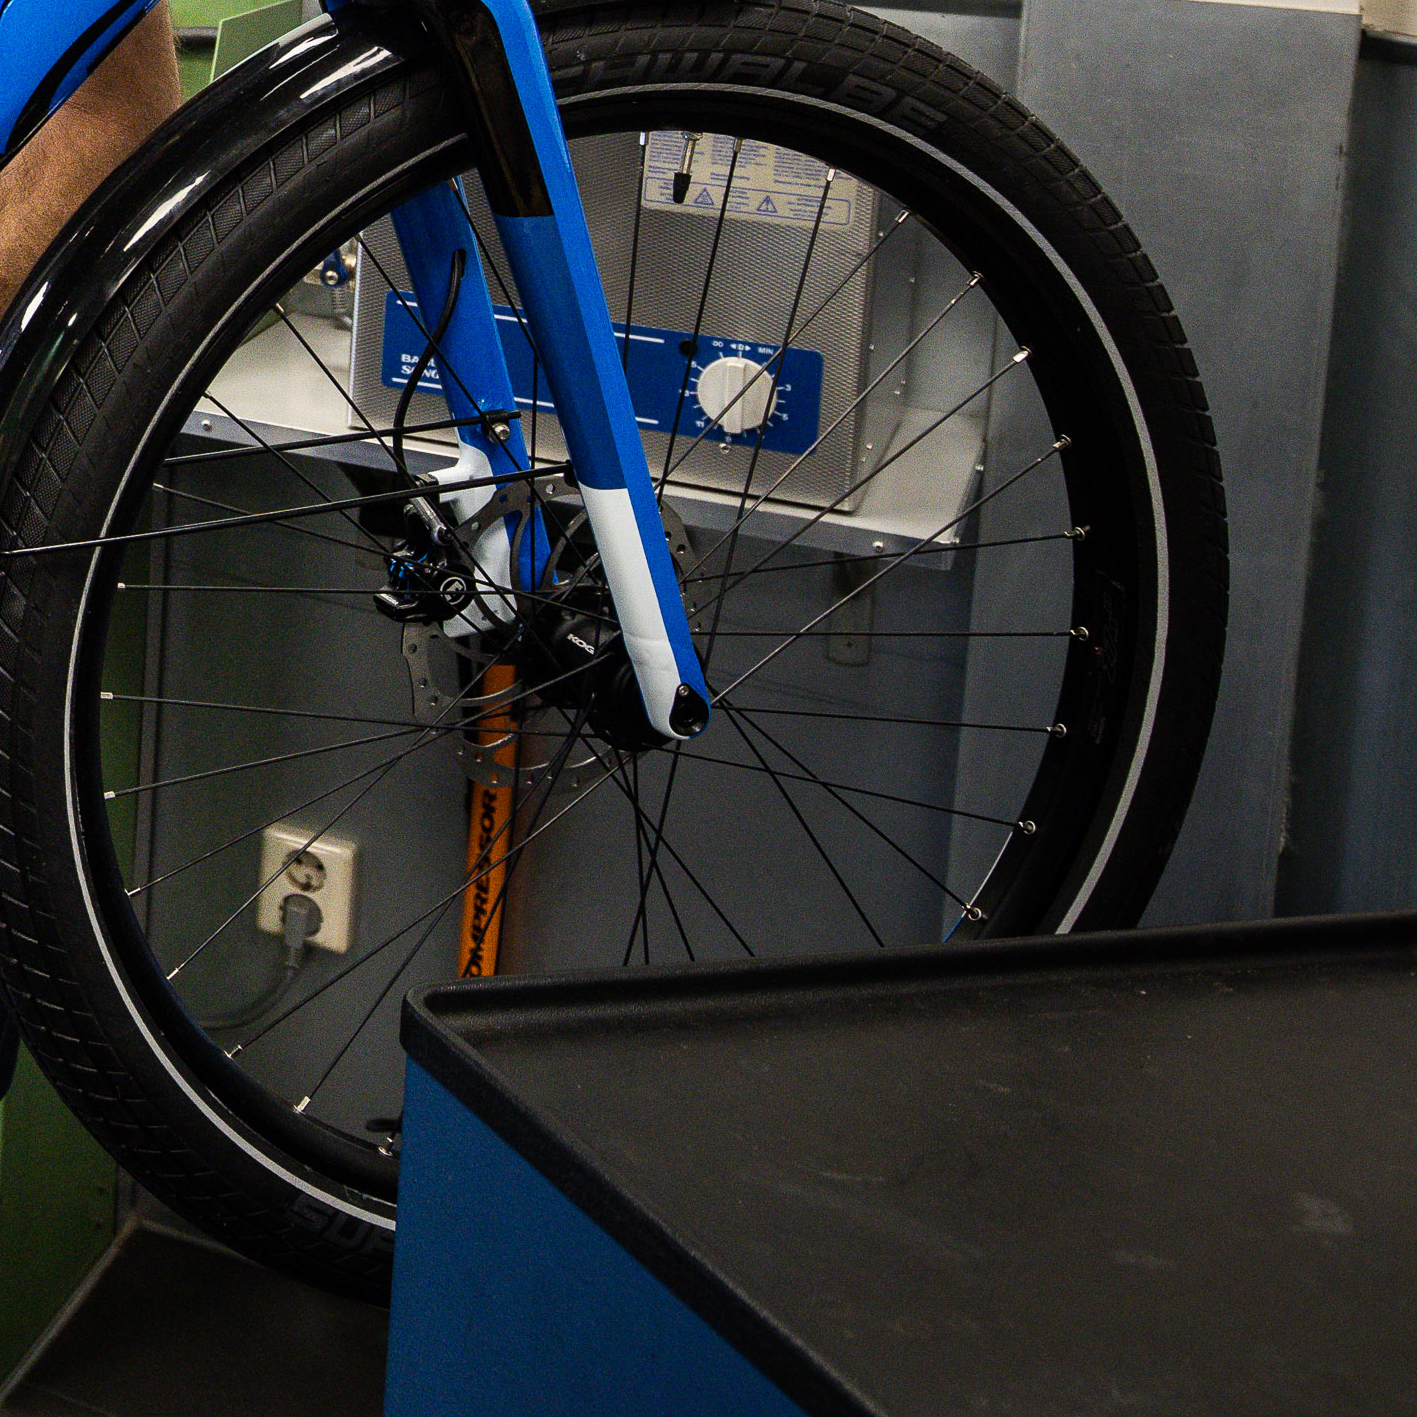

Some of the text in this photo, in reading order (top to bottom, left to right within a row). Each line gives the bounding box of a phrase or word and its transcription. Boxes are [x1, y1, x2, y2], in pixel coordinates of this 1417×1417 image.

[549, 50, 953, 138] CHWALBE
[757, 346, 774, 355] MIN
[567, 633, 595, 655] KOG
[468, 789, 497, 978] OMPRESSOR
